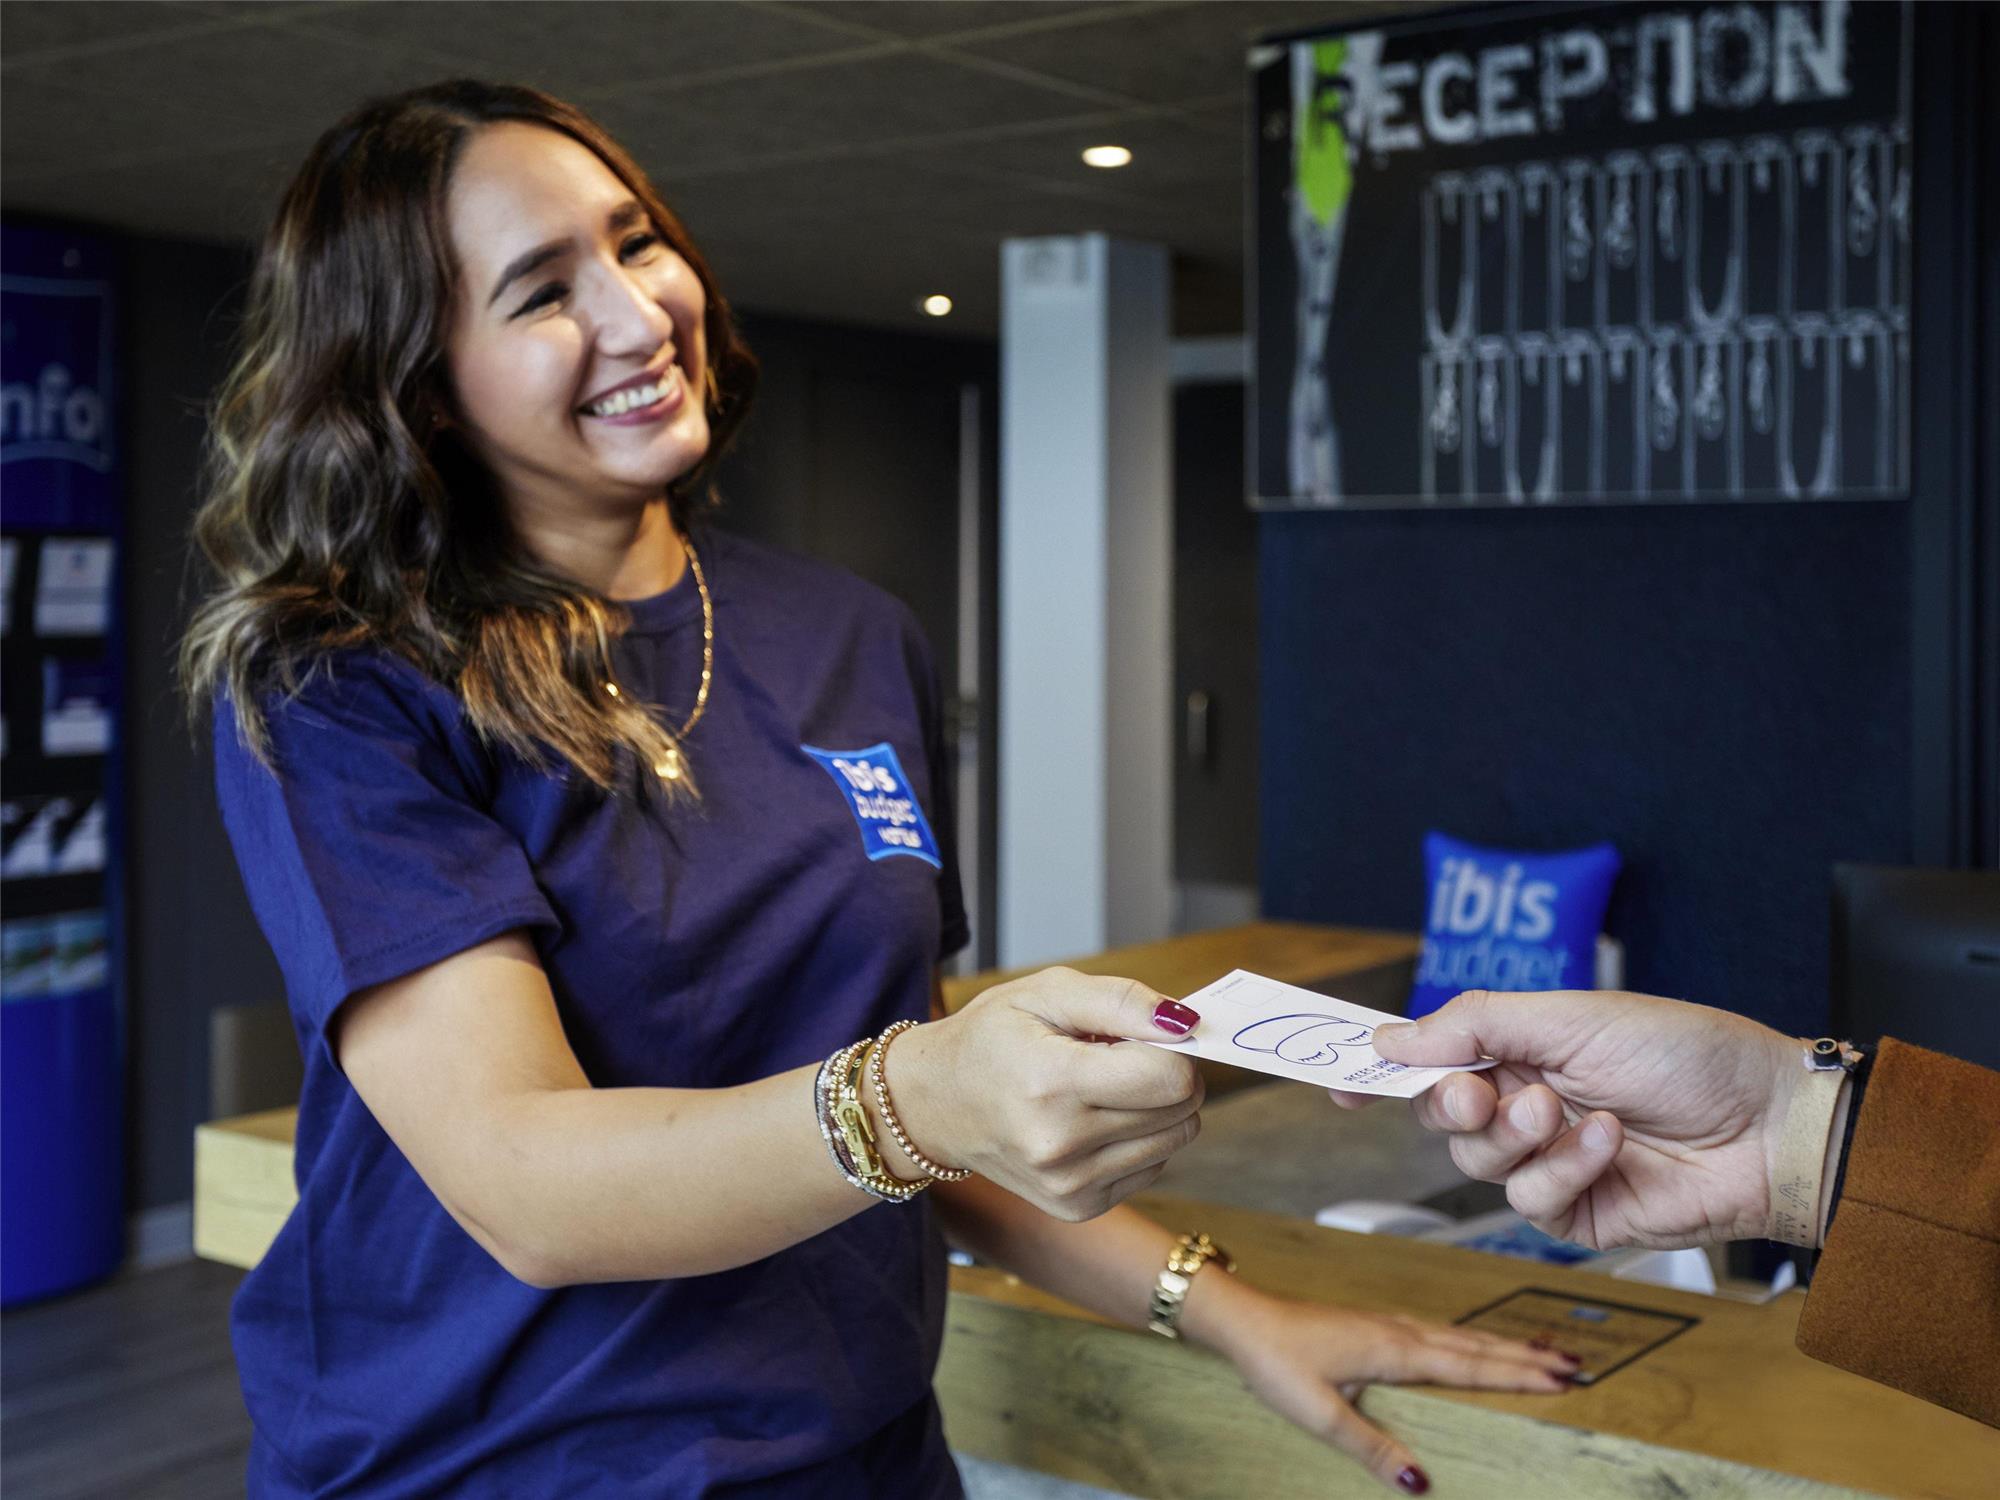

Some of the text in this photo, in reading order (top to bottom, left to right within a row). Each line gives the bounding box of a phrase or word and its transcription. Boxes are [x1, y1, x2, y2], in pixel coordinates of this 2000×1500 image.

[1291, 0, 1848, 160] RECEPTION
[0, 362, 104, 442] nfo
[1430, 857, 1558, 942] ibis
